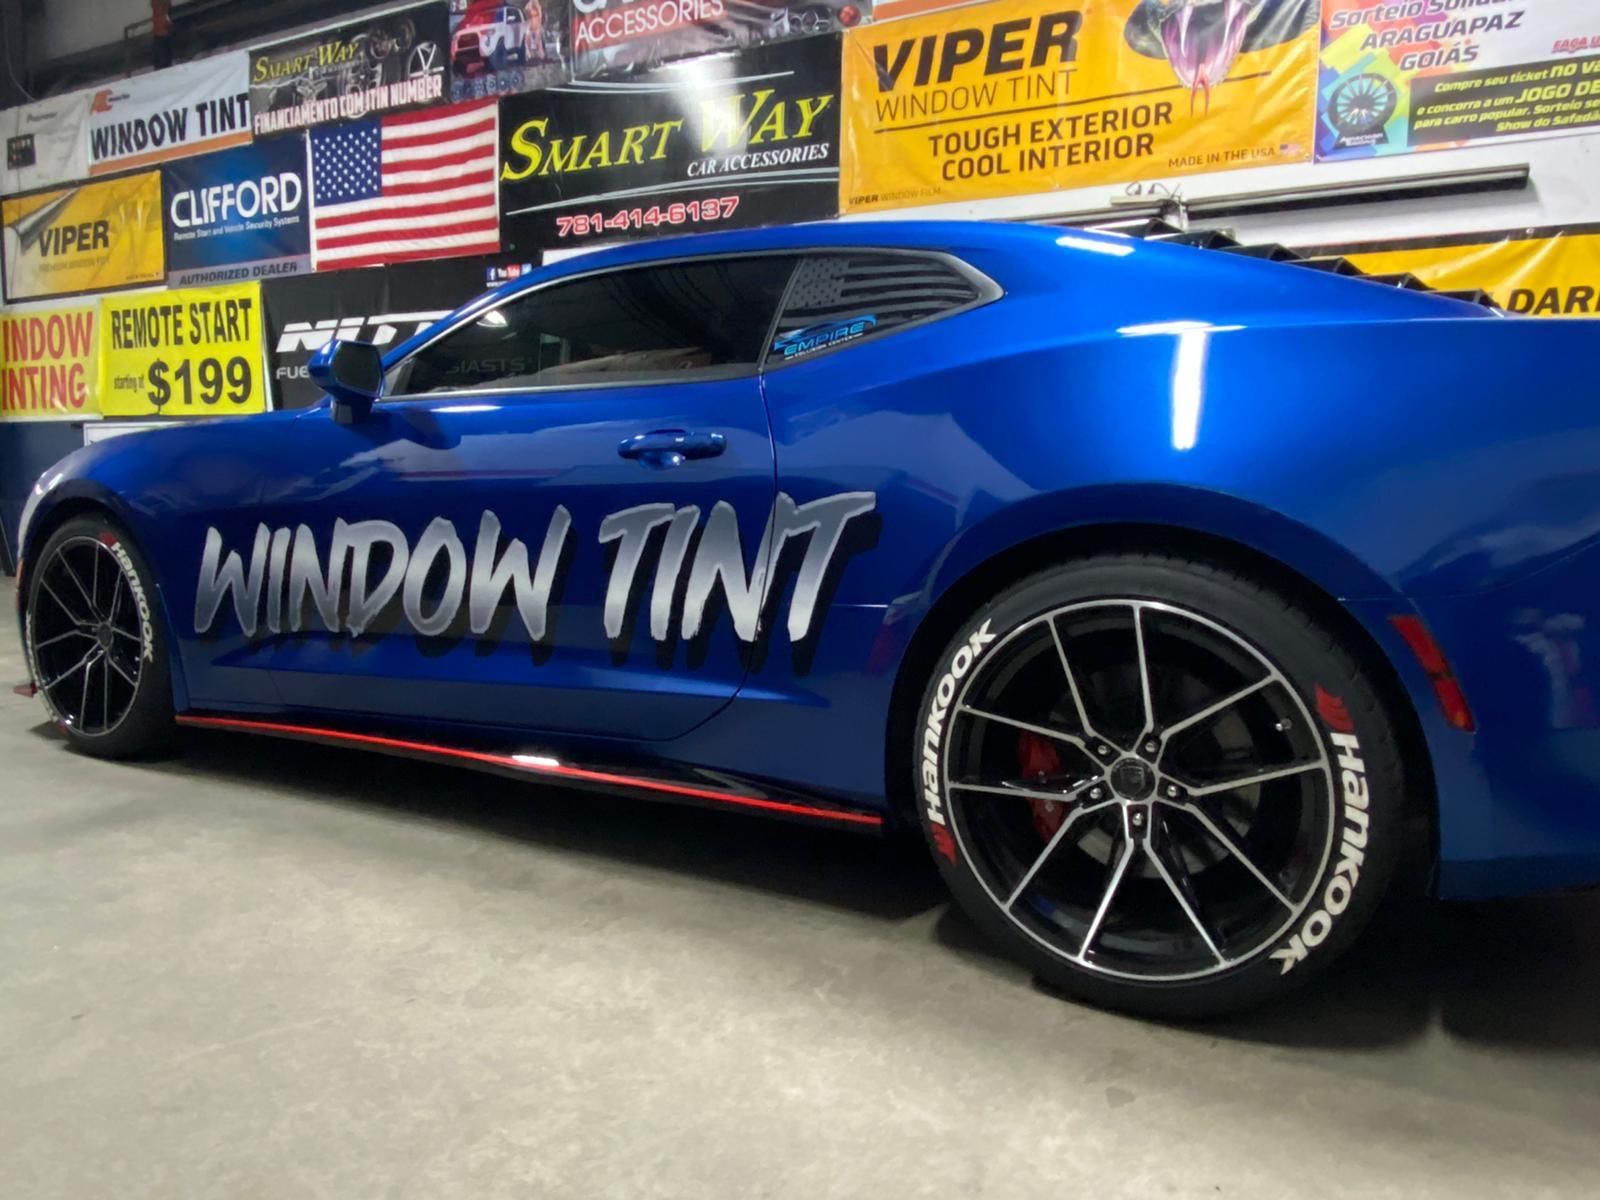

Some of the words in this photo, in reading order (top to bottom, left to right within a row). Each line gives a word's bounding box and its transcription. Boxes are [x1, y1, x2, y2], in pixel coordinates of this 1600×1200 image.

[575, 0, 724, 51] ACCESSORIES
[1331, 0, 1422, 28] Sorteio
[1360, 10, 1525, 51] ARAGUAPAZ
[873, 10, 1083, 93] VIPER
[1400, 42, 1479, 71] GOIÁS
[876, 81, 998, 122] WINDOW
[1007, 68, 1078, 102] TINT
[1434, 77, 1483, 92] Compre
[1484, 75, 1507, 86] seu
[1510, 69, 1549, 84] ticket
[1550, 62, 1578, 78] no
[254, 97, 338, 135] FINANCIAMENTO
[390, 75, 442, 106] NUMBER
[1413, 117, 1441, 130] para
[1443, 112, 1478, 125] carro
[1479, 107, 1531, 123] popular.
[1533, 99, 1582, 115] Sorteio
[1416, 105, 1425, 116] e
[1425, 99, 1481, 114] concorra
[1483, 98, 1492, 108] a
[1493, 96, 1514, 107] um
[1515, 83, 1572, 103] JOGO
[91, 108, 188, 160] WINDOW
[196, 93, 249, 137] TINT
[500, 117, 685, 182] SMART
[701, 88, 835, 153] WAY
[928, 123, 1021, 157] TOUGH
[1030, 101, 1173, 143] EXTERIOR
[1495, 120, 1532, 133] Show
[1533, 116, 1551, 127] do
[687, 159, 716, 177] CAR
[719, 142, 830, 173] ACCESSORIES
[942, 153, 1011, 181] COOL
[1019, 133, 1155, 172] INTERIOR
[1168, 155, 1203, 169] MADE
[1207, 152, 1220, 164] IN
[1223, 149, 1249, 161] THE
[1252, 147, 1275, 159] USA
[170, 172, 302, 228] CLIFFORD
[556, 196, 740, 237] 781-414-6137
[848, 194, 879, 205] VIPER
[39, 220, 110, 257] VIPER
[179, 266, 249, 286] AUTHORIZED
[252, 261, 298, 278] DEALER
[1507, 286, 1600, 315] DAR
[2, 311, 93, 363] INDOW
[111, 304, 183, 350] REMOTE
[189, 298, 252, 345] START
[784, 321, 865, 356] EMPIRE
[2, 363, 86, 410] INTING
[148, 356, 252, 408] $199
[194, 504, 571, 643] WINDOW
[599, 491, 876, 643] TINT
